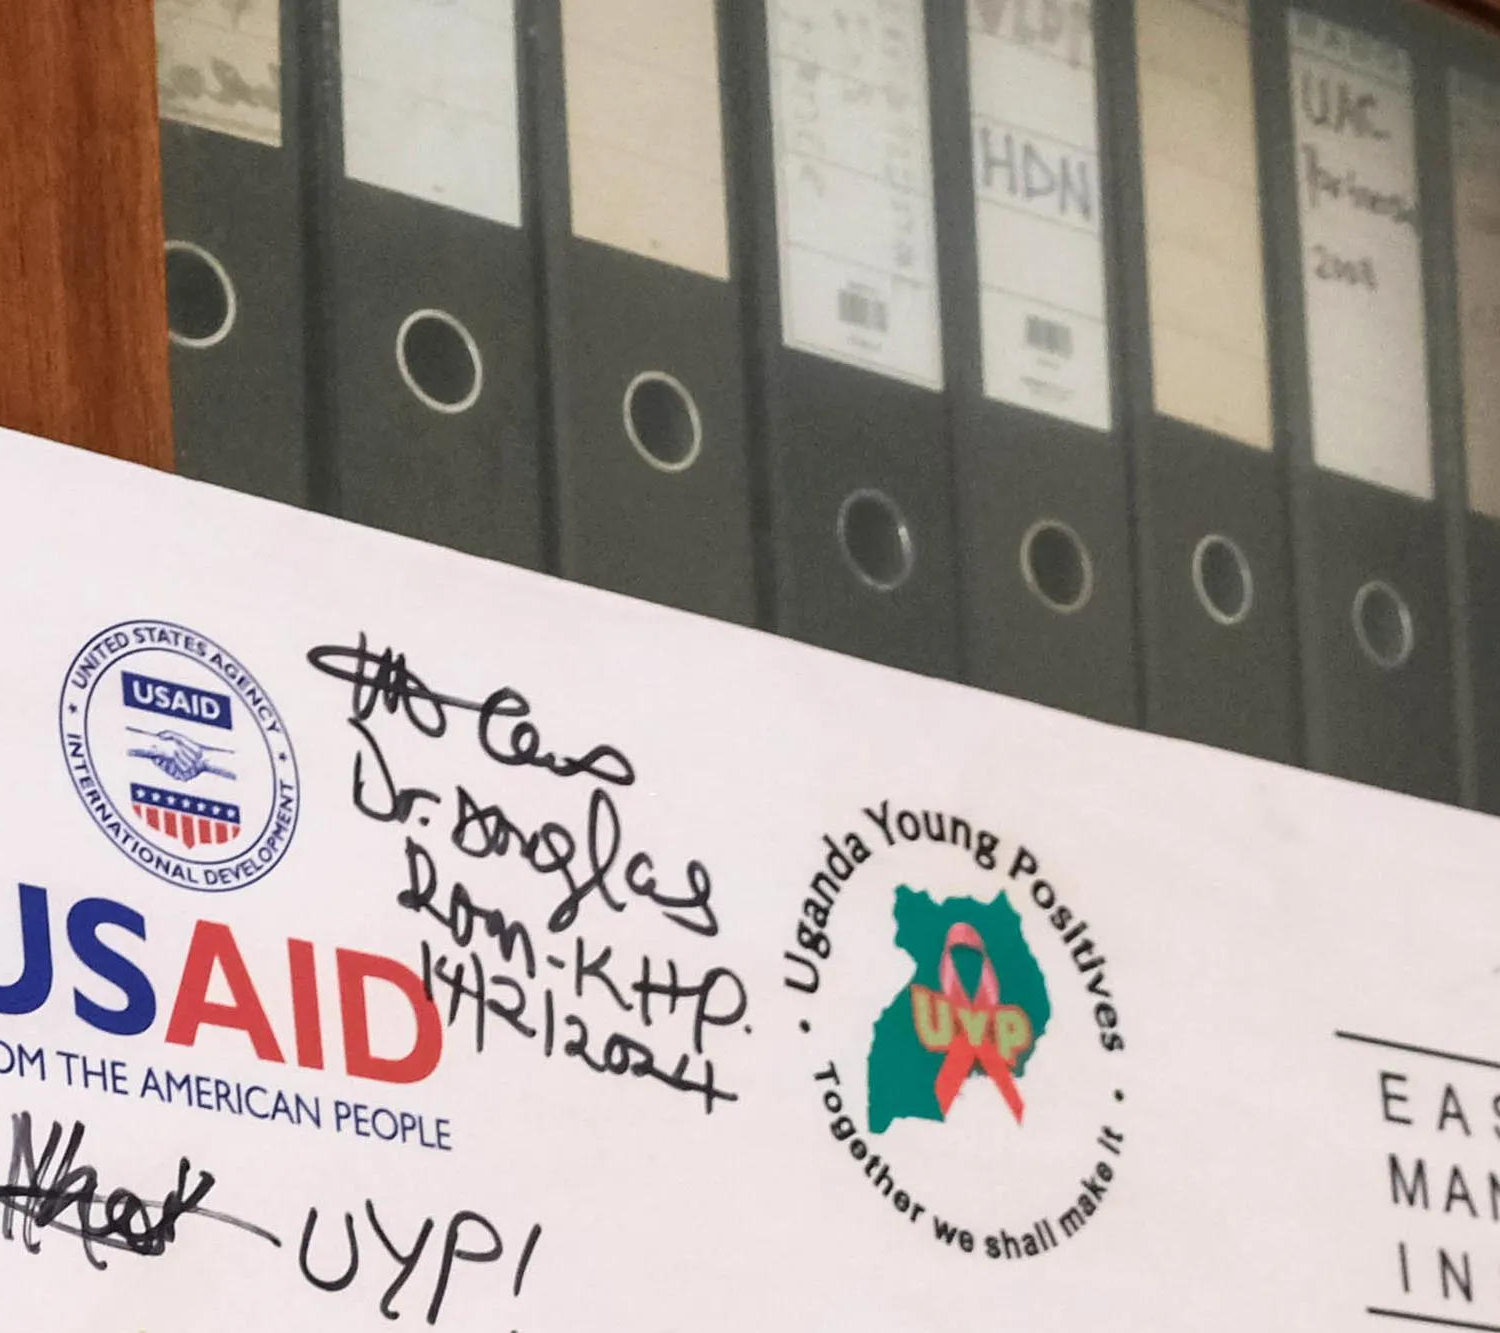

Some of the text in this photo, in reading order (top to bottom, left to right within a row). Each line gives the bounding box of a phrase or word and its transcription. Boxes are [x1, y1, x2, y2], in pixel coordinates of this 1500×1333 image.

[977, 125, 1092, 223] HDN
[72, 626, 281, 733] UNITED STATES AGENCY
[133, 680, 220, 720] USAID
[67, 733, 294, 885] INTERNATIONAL DEVELOPMENT
[784, 800, 1124, 1052] Uganda Young Positives
[57, 1050, 128, 1095] THE
[141, 1068, 320, 1129] AMERICAN
[335, 1101, 452, 1151] PEOPLE
[814, 1061, 1123, 1260] Together we shall make it
